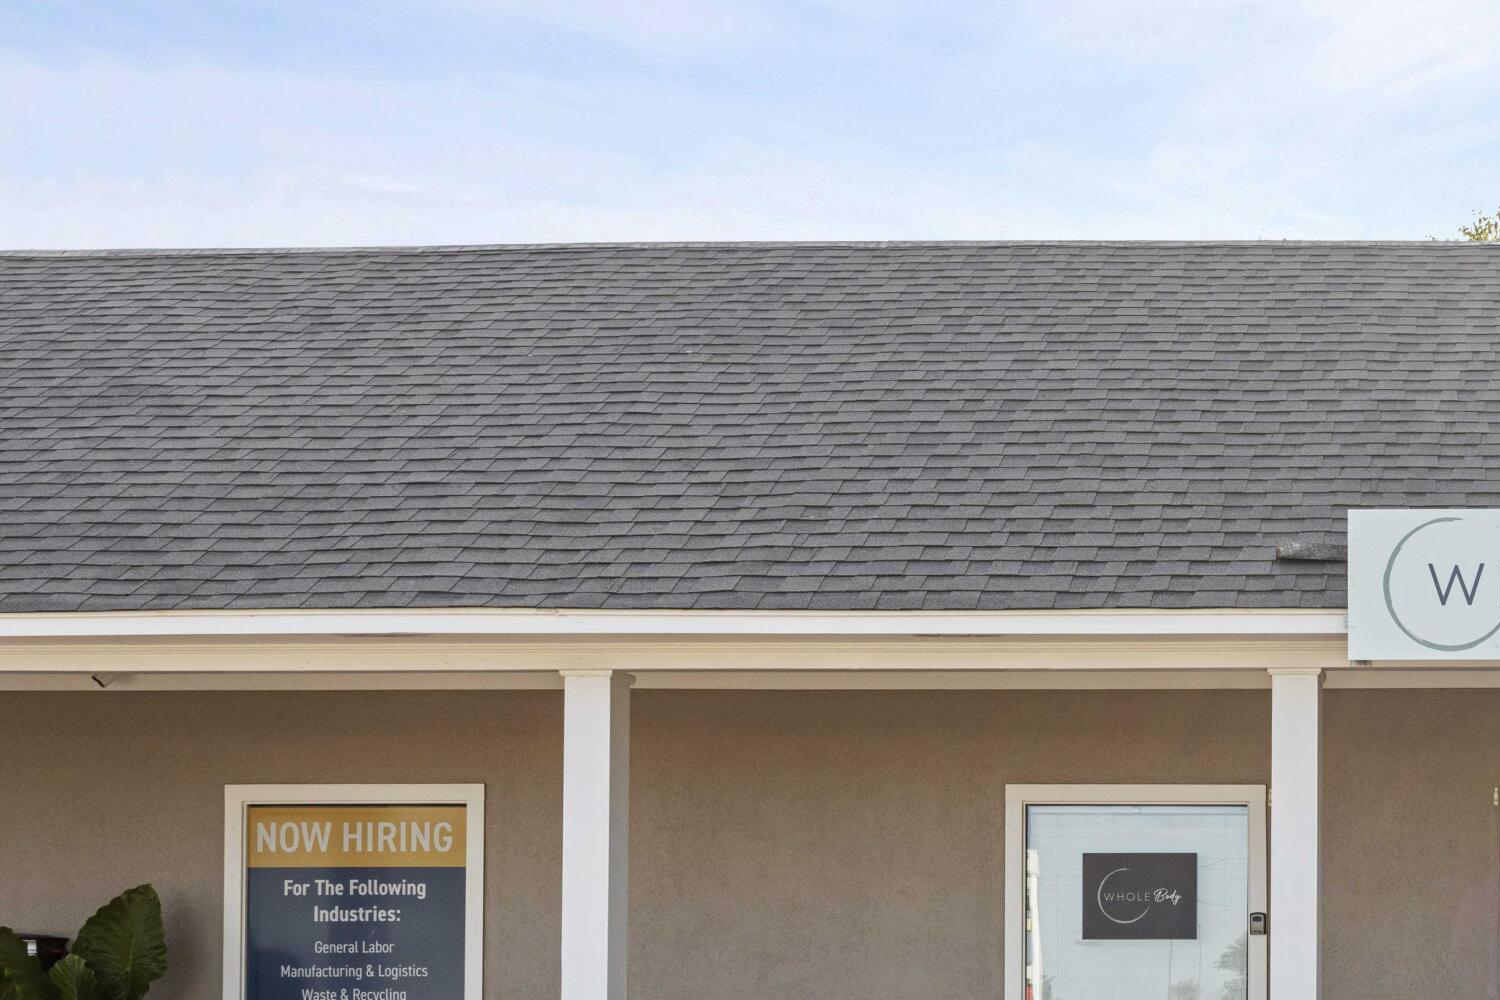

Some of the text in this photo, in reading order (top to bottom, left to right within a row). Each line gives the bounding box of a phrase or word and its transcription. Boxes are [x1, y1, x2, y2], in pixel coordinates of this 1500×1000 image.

[256, 821, 453, 853] NOW HIRING
[283, 879, 427, 900] For The Following
[1104, 888, 1181, 905] WHOLE Body
[313, 905, 401, 923] Industries:
[314, 940, 395, 954] General Labor
[280, 964, 428, 981] Manufacturing & Logistics
